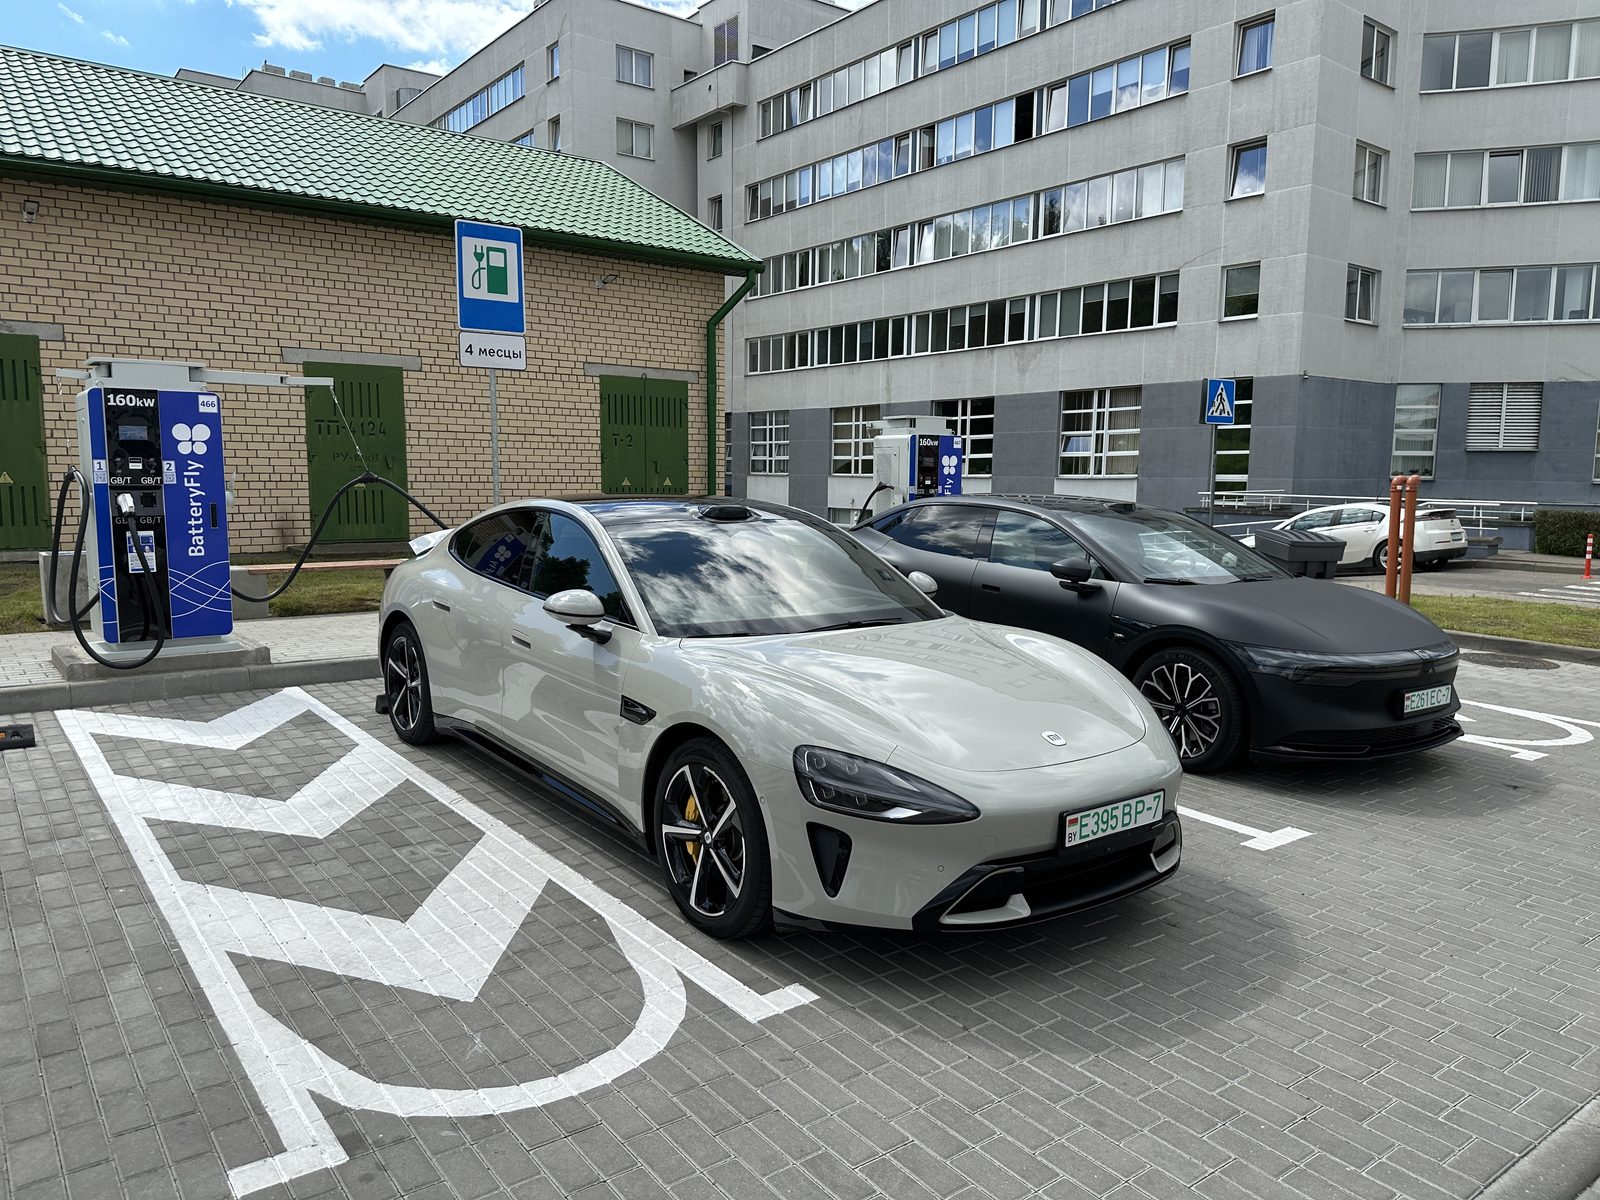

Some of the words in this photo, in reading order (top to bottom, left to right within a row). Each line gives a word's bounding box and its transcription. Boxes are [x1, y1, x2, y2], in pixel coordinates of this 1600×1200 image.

[465, 343, 474, 356] 4
[478, 347, 522, 360] месцы
[96, 462, 104, 471] 1
[165, 462, 173, 471] 2
[110, 476, 132, 485] GB/T
[140, 476, 162, 485] GB/T
[183, 460, 206, 557] BatteryFly
[139, 516, 162, 524] GB/T
[1067, 831, 1078, 843] BY
